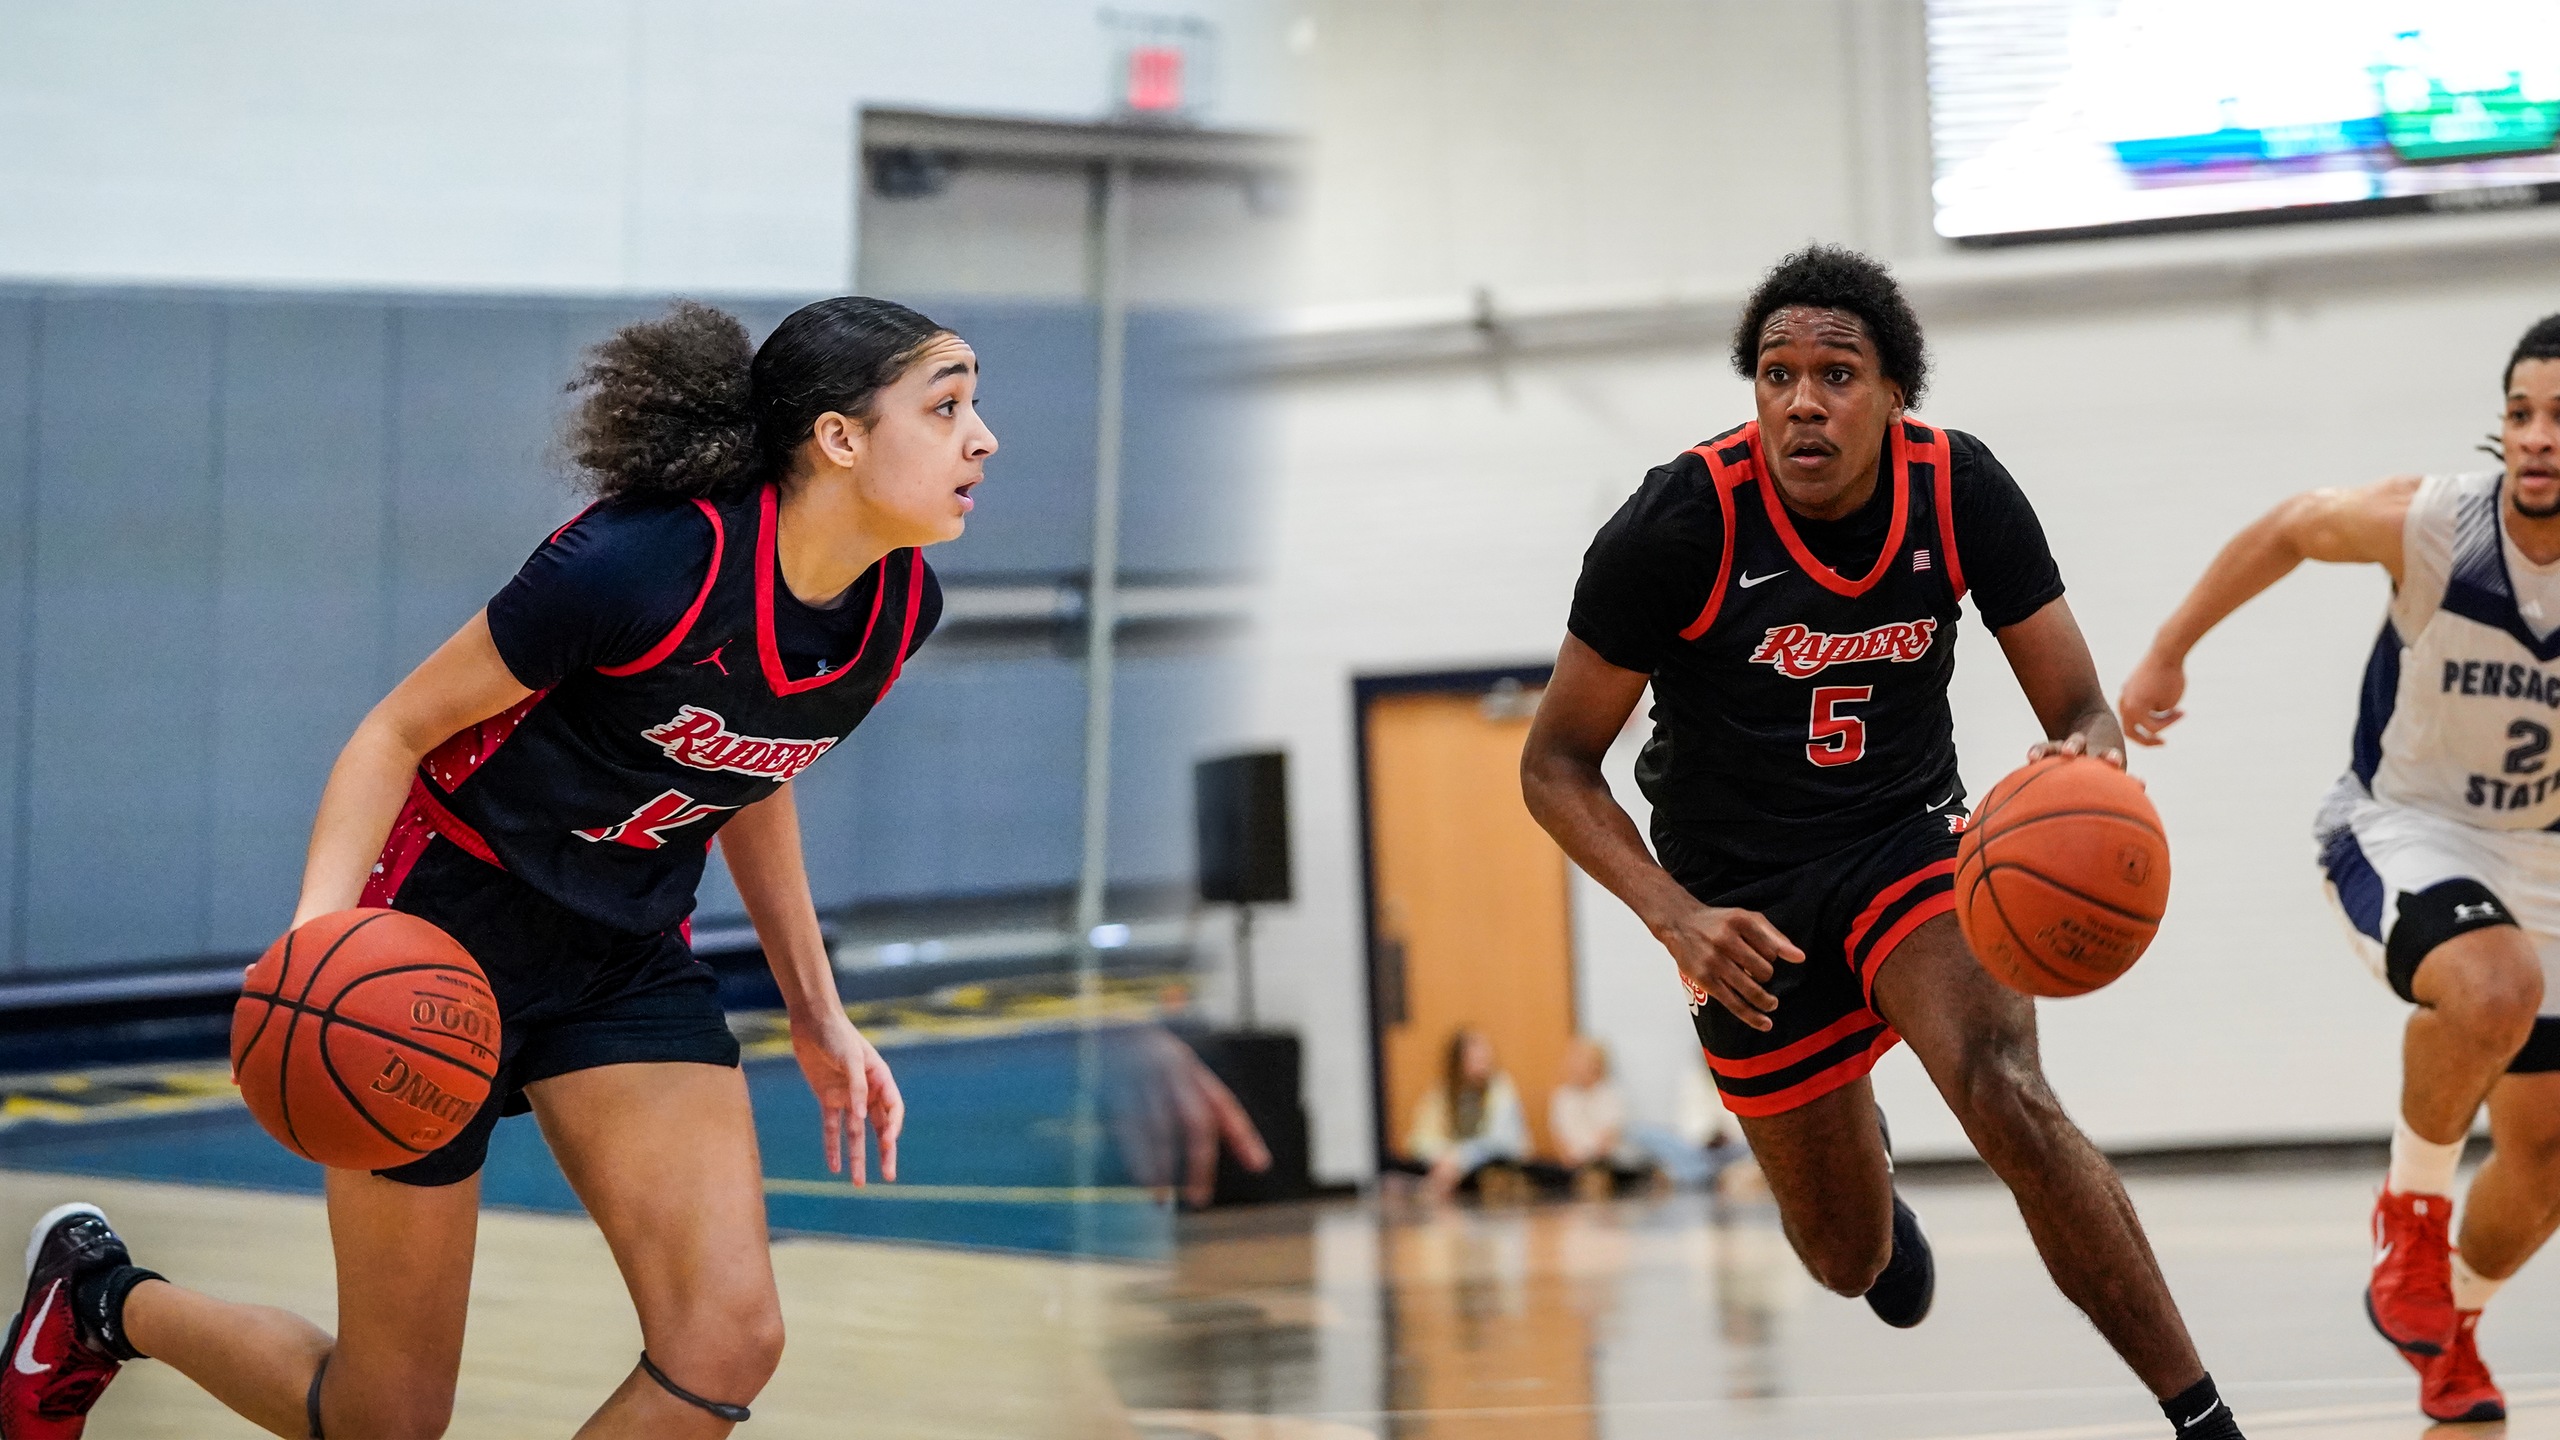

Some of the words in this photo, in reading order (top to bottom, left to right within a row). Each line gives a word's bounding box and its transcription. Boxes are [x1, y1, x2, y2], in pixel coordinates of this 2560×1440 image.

[1749, 616, 1937, 679] RAIDERS
[641, 704, 839, 782] RAIDERS
[1806, 684, 1874, 768] 5
[2504, 717, 2551, 775] 2
